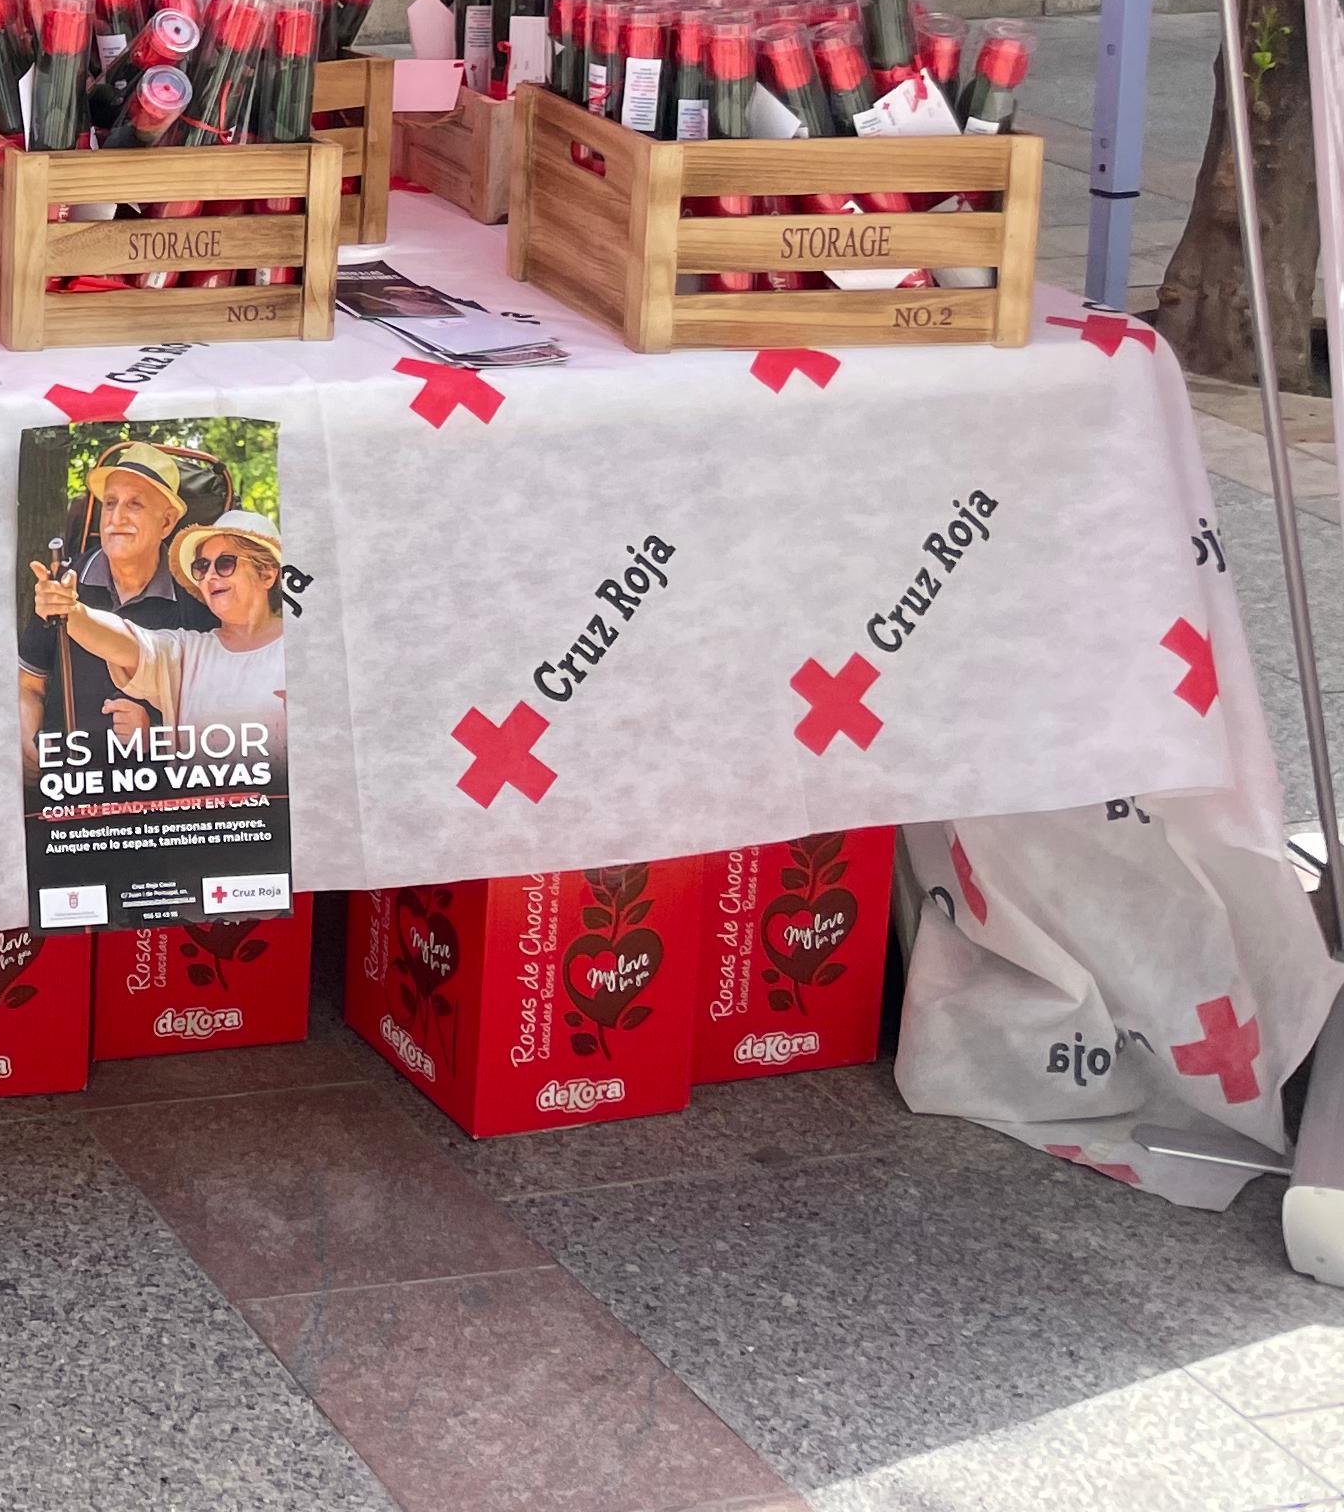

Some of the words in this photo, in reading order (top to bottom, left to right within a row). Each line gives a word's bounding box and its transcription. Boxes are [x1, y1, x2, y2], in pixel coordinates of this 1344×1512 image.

[128, 230, 222, 260] STORAGE
[781, 226, 892, 259] STORAGE
[226, 305, 277, 322] NO.3
[893, 307, 954, 327] NO.2
[105, 357, 175, 383] Cruz
[866, 572, 942, 653] Cruz
[924, 486, 999, 571] Roja
[282, 565, 314, 618] ja
[532, 612, 618, 703] Cruz
[596, 533, 677, 622] Roja
[38, 731, 92, 768] ES
[107, 722, 270, 764] MEJOR
[40, 770, 104, 801] QUE
[112, 768, 157, 792] NO
[164, 762, 272, 789] VAYAS
[42, 805, 74, 819] CON
[205, 797, 226, 809] EN
[45, 843, 90, 854] Aunque
[92, 842, 107, 851] no
[109, 839, 120, 849] lo
[122, 839, 157, 850] sepas,
[159, 833, 205, 847] también
[208, 834, 221, 843] es
[223, 831, 272, 842] maltrato
[51, 830, 67, 839] No
[69, 826, 133, 838] subestimes
[135, 827, 142, 835] a
[144, 824, 160, 834] las
[162, 821, 212, 834] personas
[214, 819, 266, 831] mayores.
[232, 888, 257, 898] Cruz
[258, 886, 282, 898] Roja
[719, 850, 743, 913] Choco
[742, 874, 757, 912] Roses
[364, 916, 380, 981] Rosas
[410, 926, 429, 964] My
[429, 931, 451, 959] love
[543, 917, 558, 953] Roses
[716, 920, 738, 947] de
[739, 921, 754, 956] Roses
[784, 925, 812, 950] My
[813, 911, 845, 933] love
[126, 928, 152, 994] Rosas
[517, 961, 539, 991] de
[587, 967, 615, 992] My
[617, 952, 649, 975] love
[541, 963, 555, 1000] Roses
[710, 954, 736, 1021] Rosas
[155, 1008, 242, 1038] deKora
[510, 997, 538, 1067] Rosas
[380, 1015, 435, 1081] deKora
[735, 1033, 818, 1064] deKora
[538, 1079, 624, 1112] deKora
